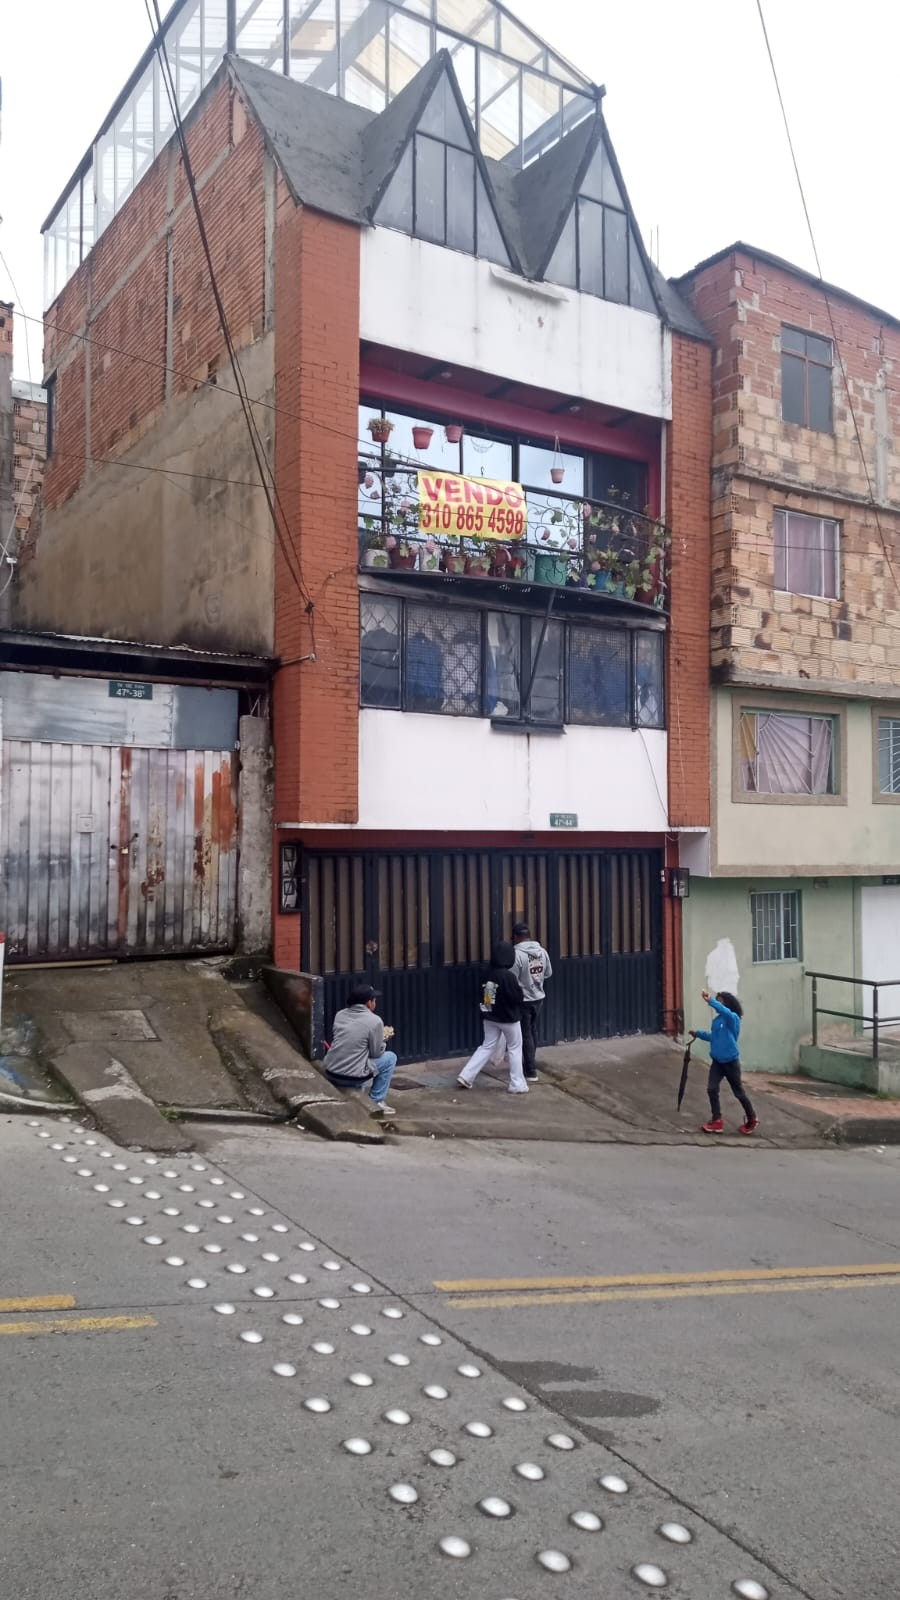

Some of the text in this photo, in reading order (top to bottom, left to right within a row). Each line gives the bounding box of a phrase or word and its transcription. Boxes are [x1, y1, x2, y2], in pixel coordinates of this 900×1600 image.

[422, 477, 523, 508] VENDO
[421, 503, 524, 535] 310 865 4598
